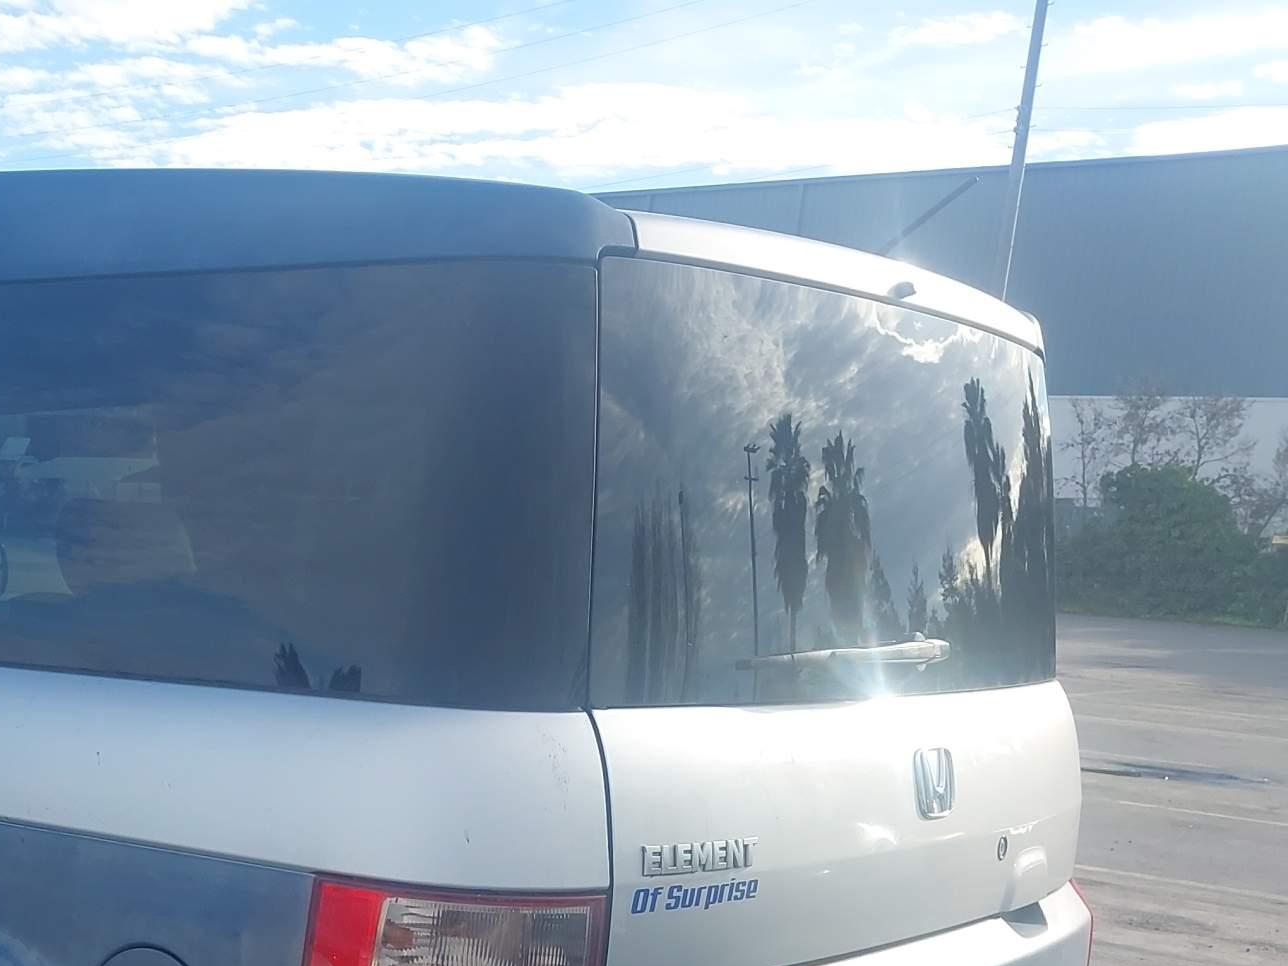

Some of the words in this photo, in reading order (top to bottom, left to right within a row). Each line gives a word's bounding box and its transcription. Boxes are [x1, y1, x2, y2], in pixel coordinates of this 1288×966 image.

[641, 836, 759, 877] ELEMENT
[631, 887, 664, 914] Of
[665, 878, 759, 910] Surprise
